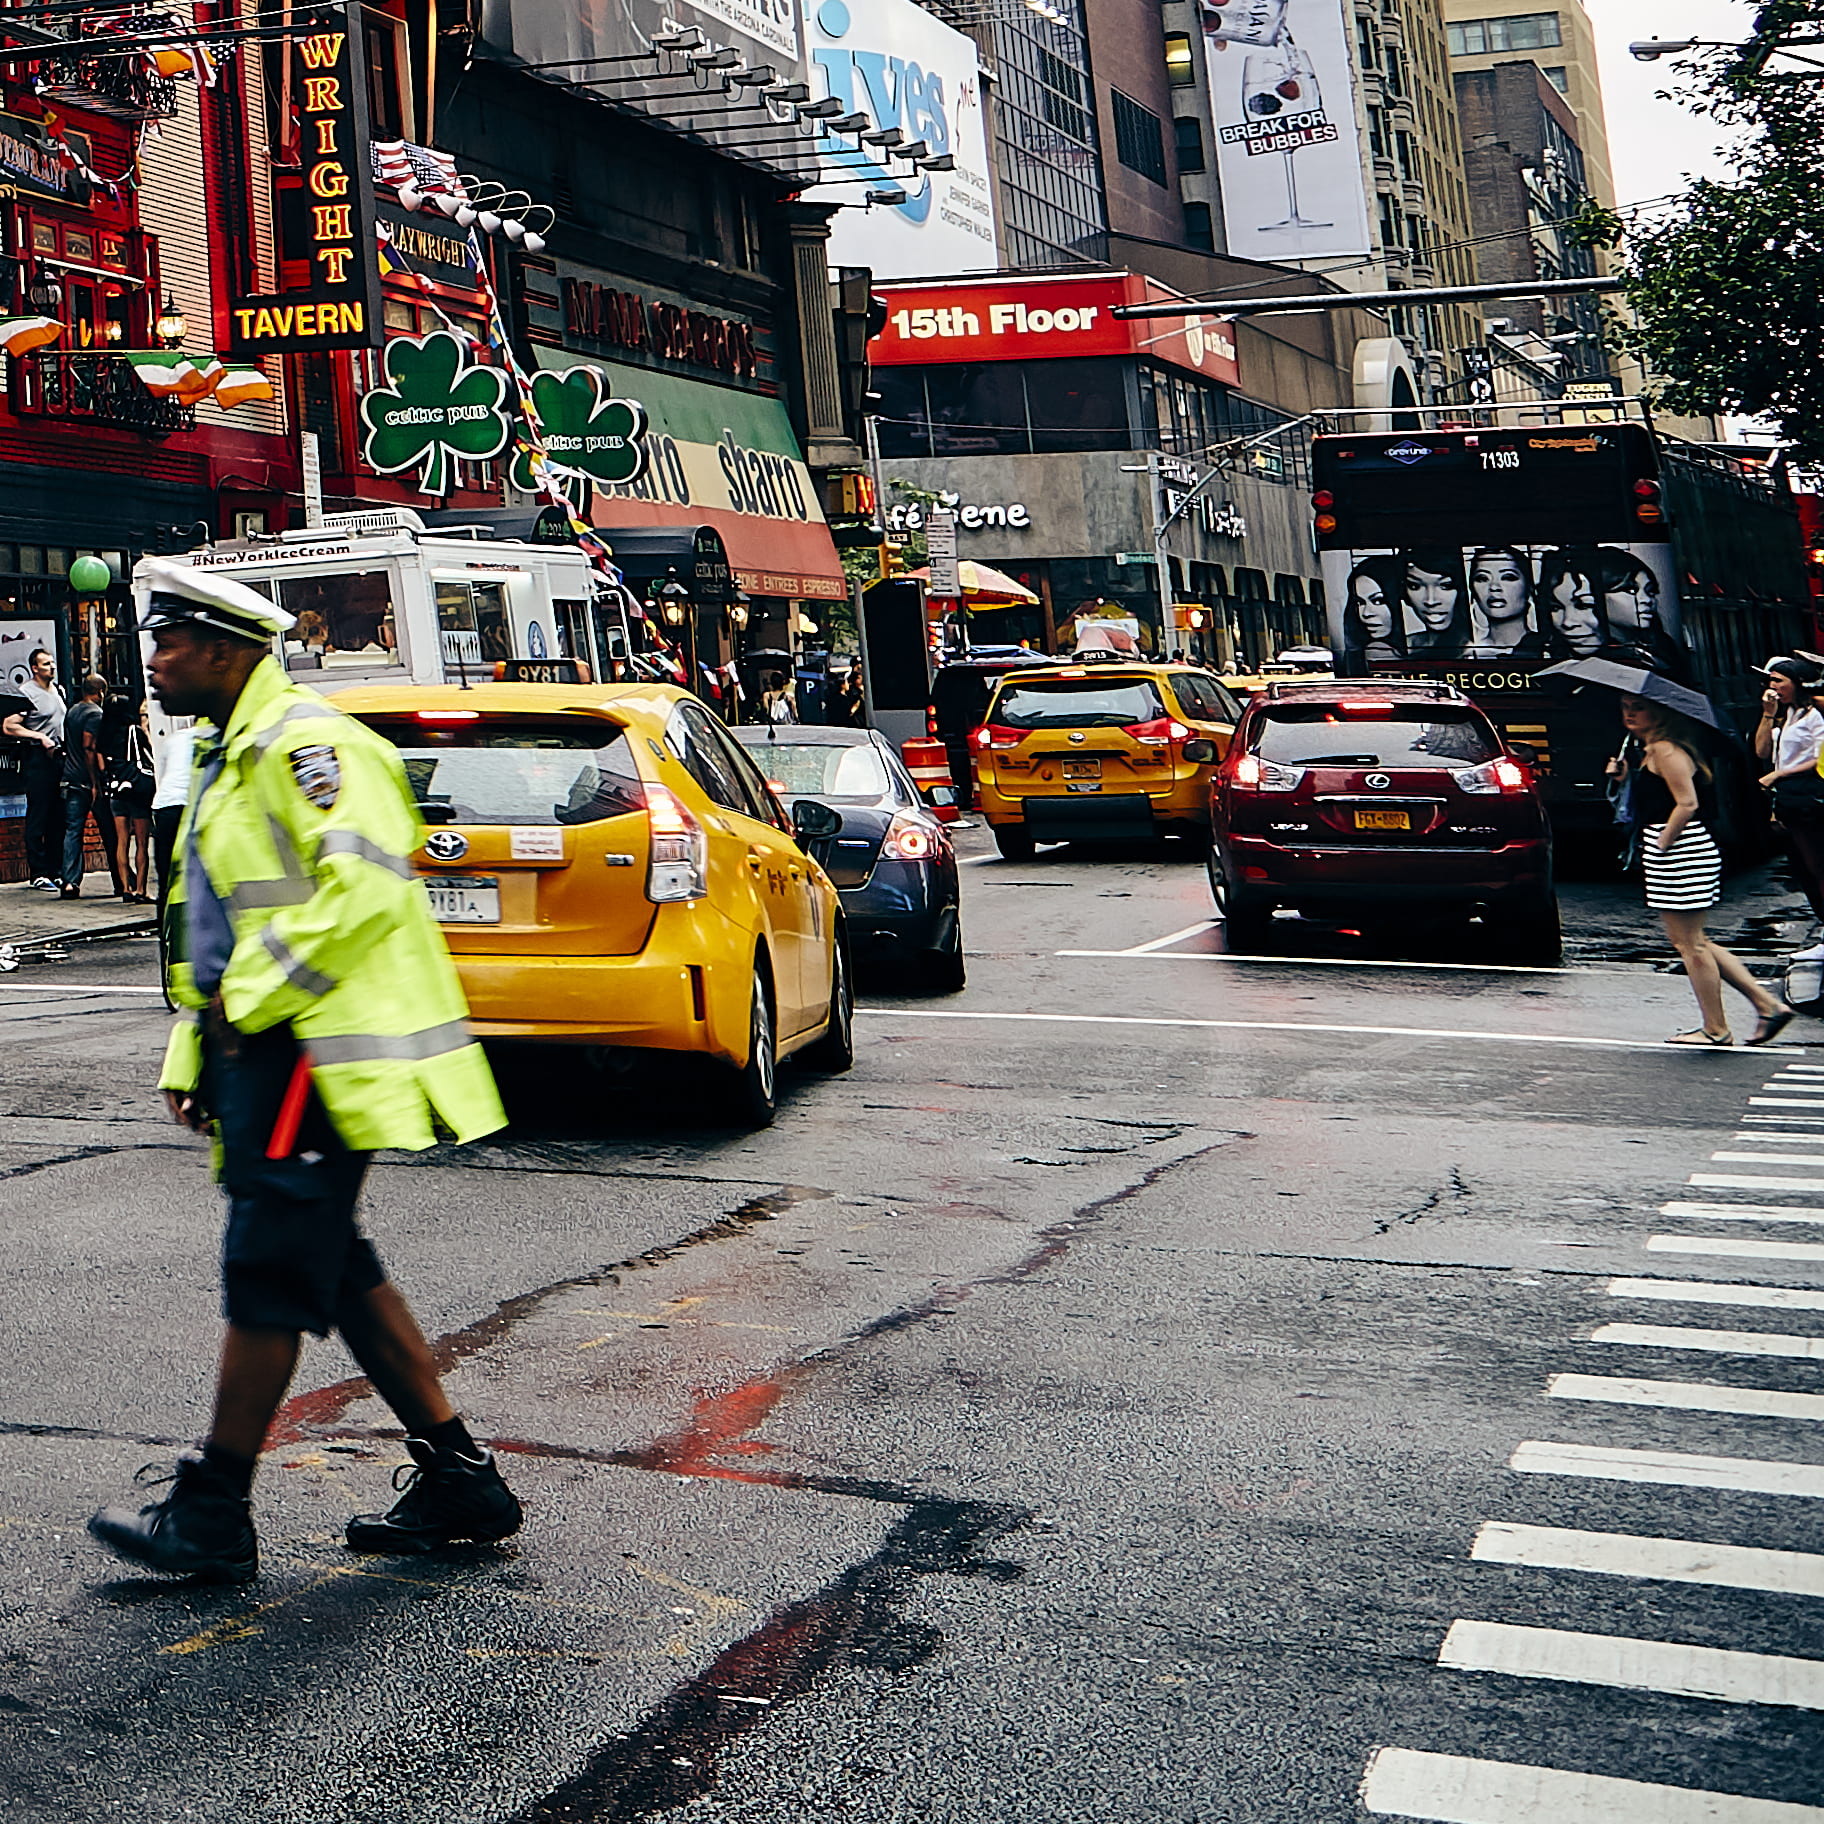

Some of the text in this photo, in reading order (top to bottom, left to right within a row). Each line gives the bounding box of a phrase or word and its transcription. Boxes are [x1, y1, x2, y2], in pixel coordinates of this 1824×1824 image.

[1222, 110, 1325, 144] BREAK FOR
[1251, 125, 1337, 155] BUBBLES
[390, 221, 469, 269] LAYWRIGHT
[233, 301, 365, 340] TAVERN
[891, 303, 1098, 340] 15th Floor
[717, 427, 811, 524] sbarro
[1480, 451, 1520, 470] 71303
[191, 543, 351, 568] #NewYorkIceCream
[764, 575, 841, 597] ENTREES ESPRESSO
[518, 666, 561, 682] 9Y81
